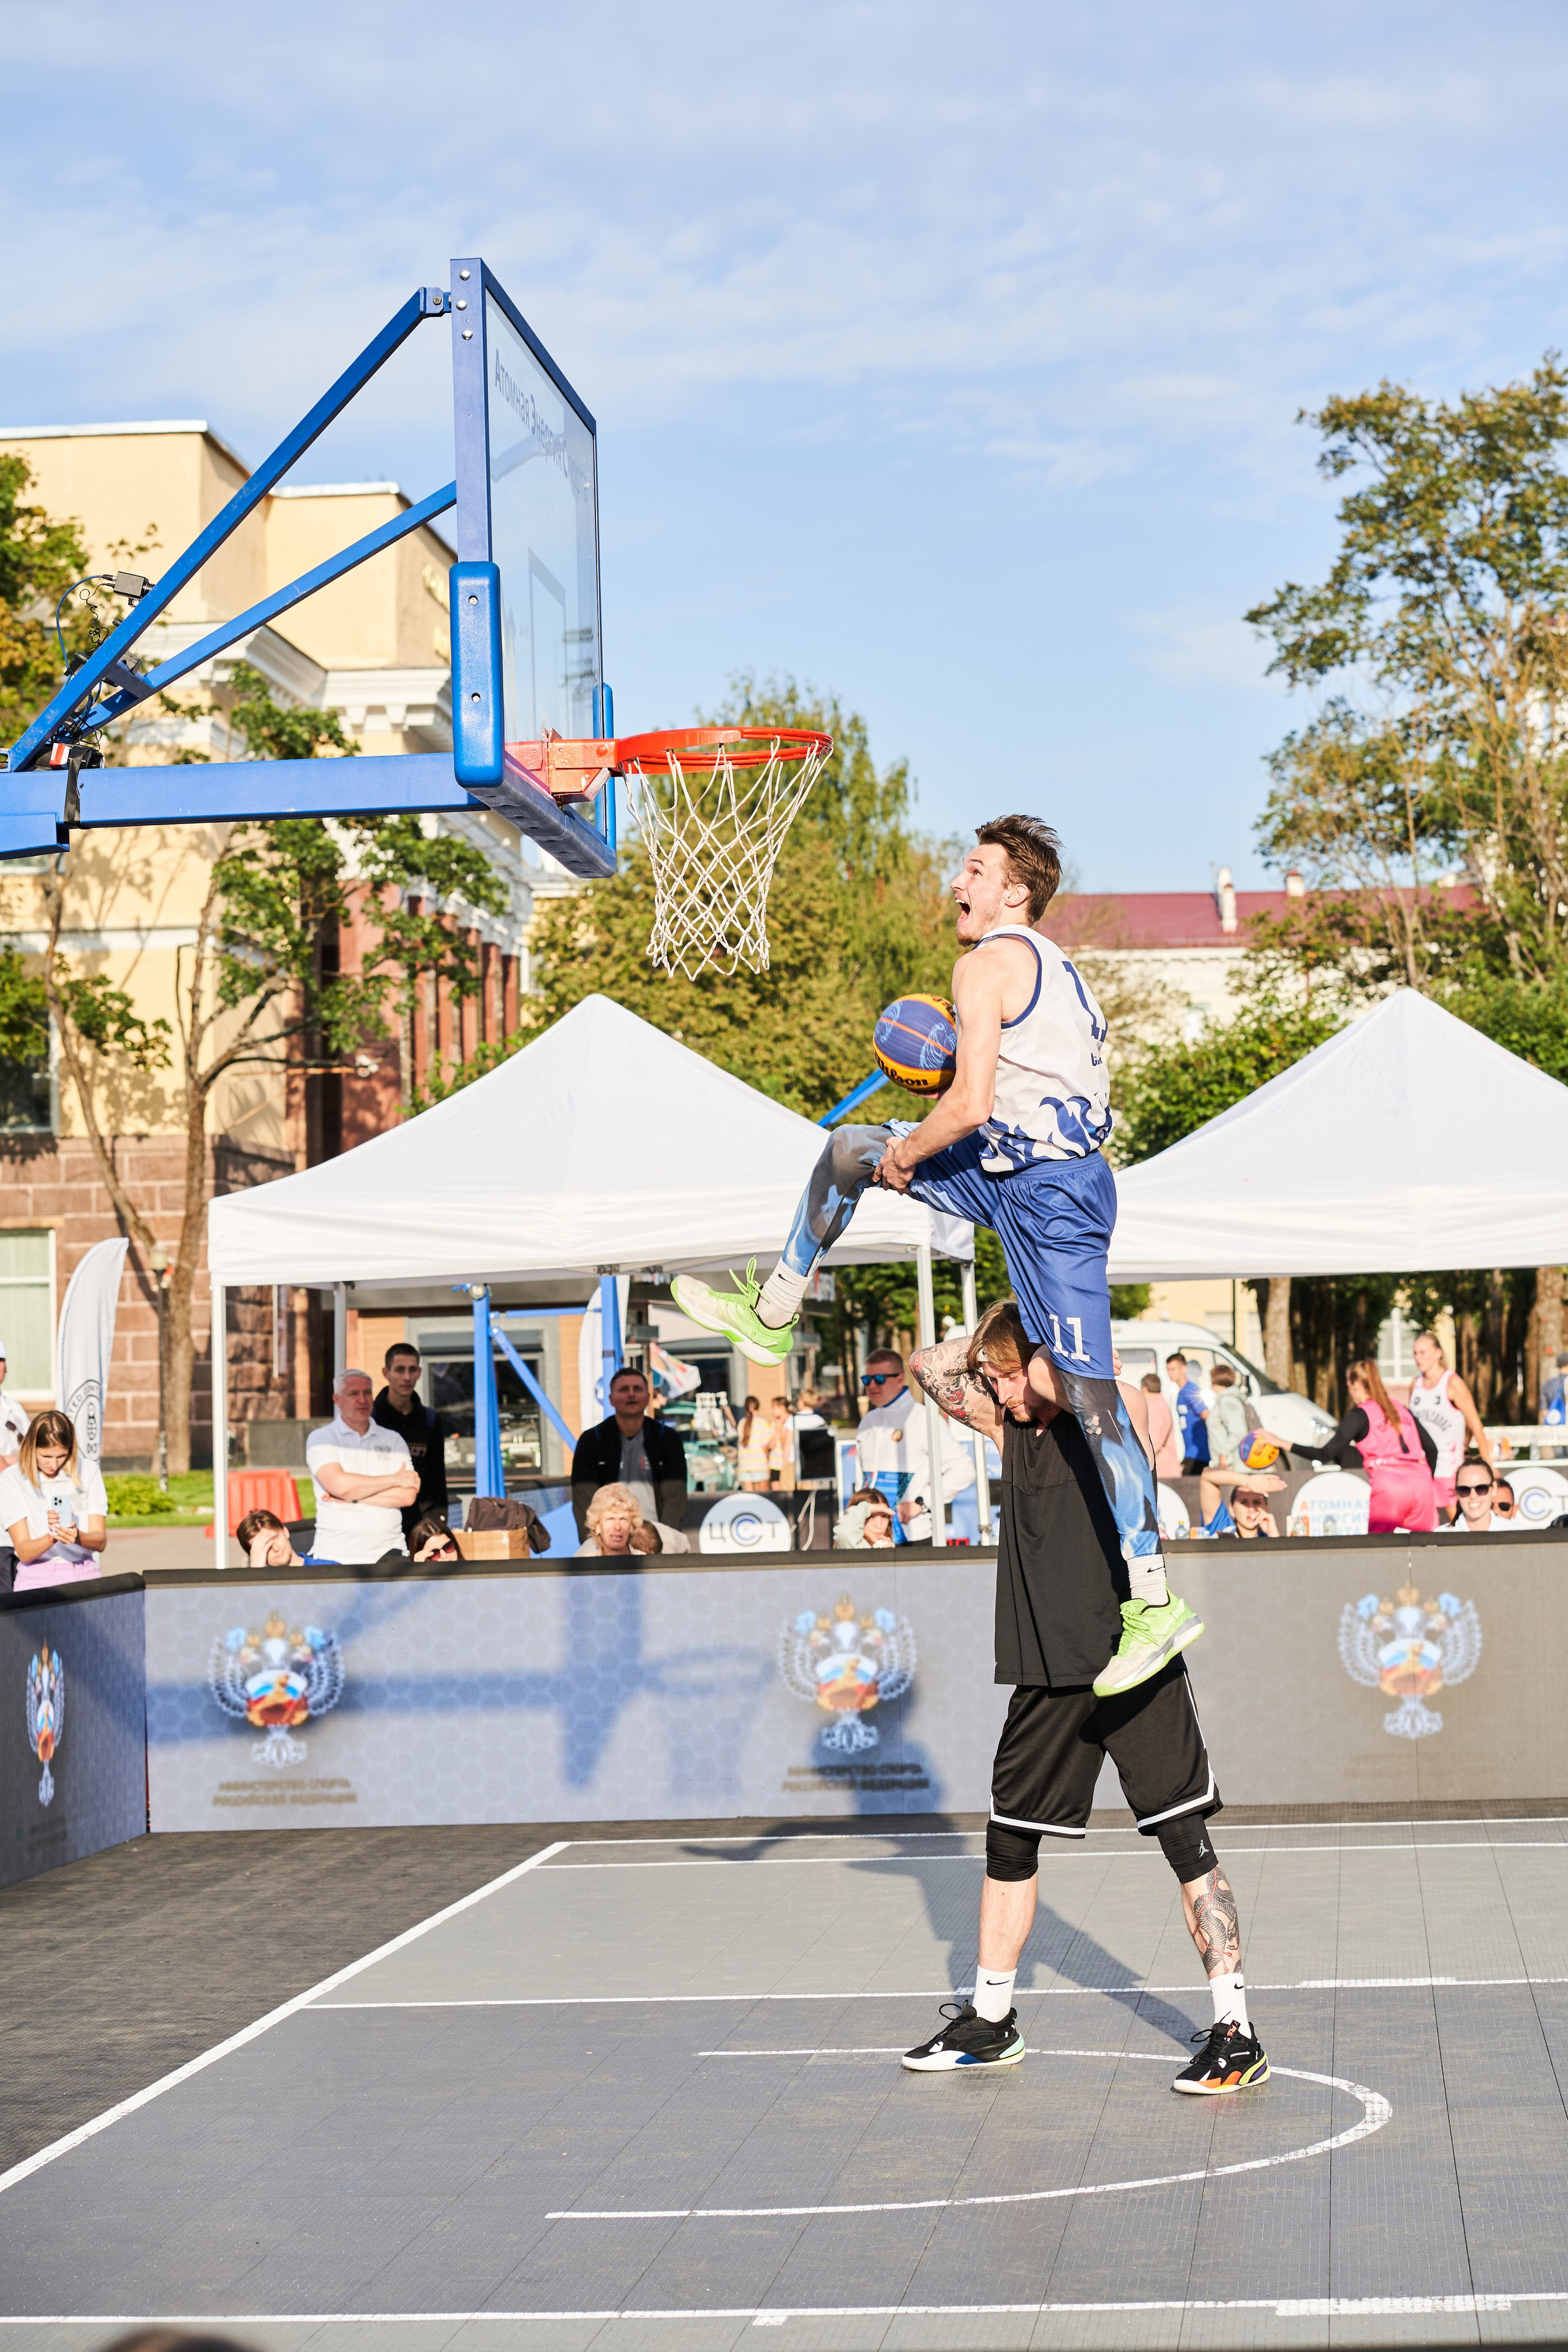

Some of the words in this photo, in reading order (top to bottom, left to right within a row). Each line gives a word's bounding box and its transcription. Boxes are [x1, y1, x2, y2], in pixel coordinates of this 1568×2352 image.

[495, 348, 530, 429] Атомная
[530, 394, 562, 471] Энергия
[1061, 960, 1108, 1043] 1
[1049, 1314, 1090, 1362] 11
[709, 1512, 780, 1547] ЦСТ
